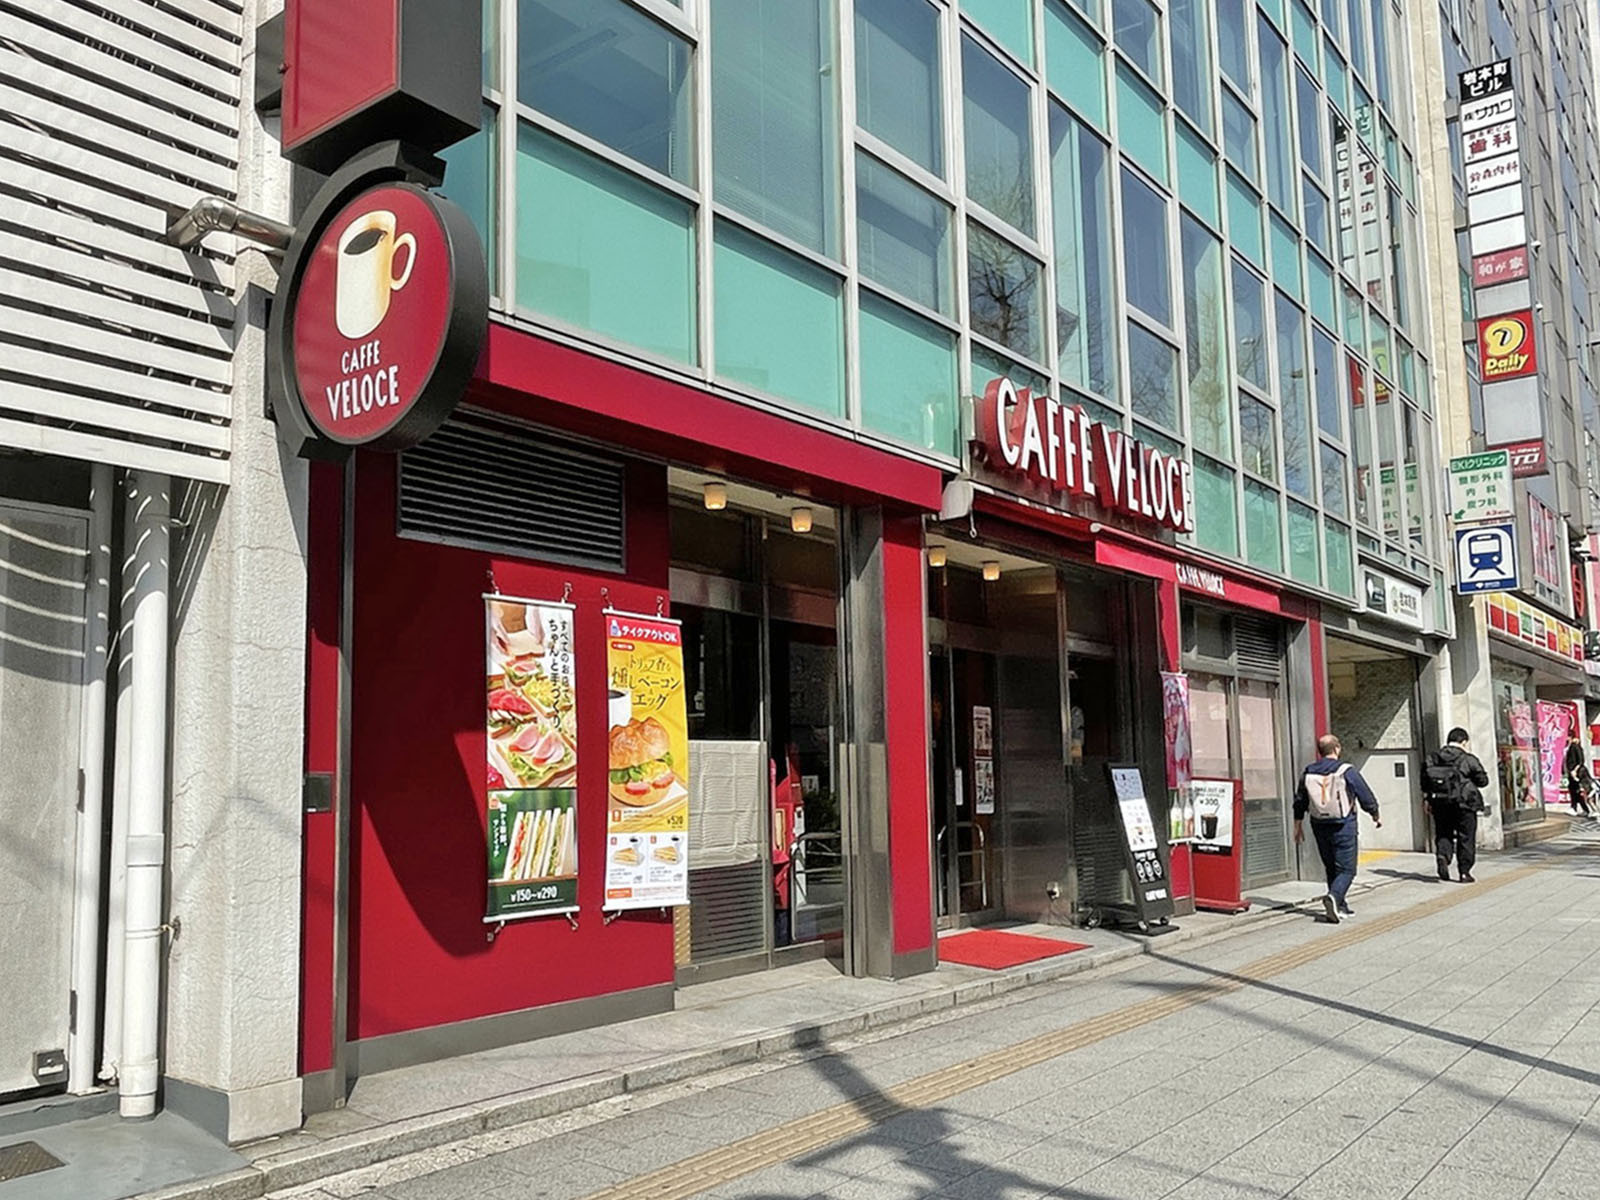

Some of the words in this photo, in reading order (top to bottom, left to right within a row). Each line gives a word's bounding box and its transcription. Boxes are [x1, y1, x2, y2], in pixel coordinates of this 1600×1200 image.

[1463, 62, 1508, 86] 岩本町
[1470, 77, 1503, 97] ビル
[1486, 353, 1529, 371] Daily
[326, 364, 400, 422] VELOCE
[1101, 423, 1193, 534] VELOCE
